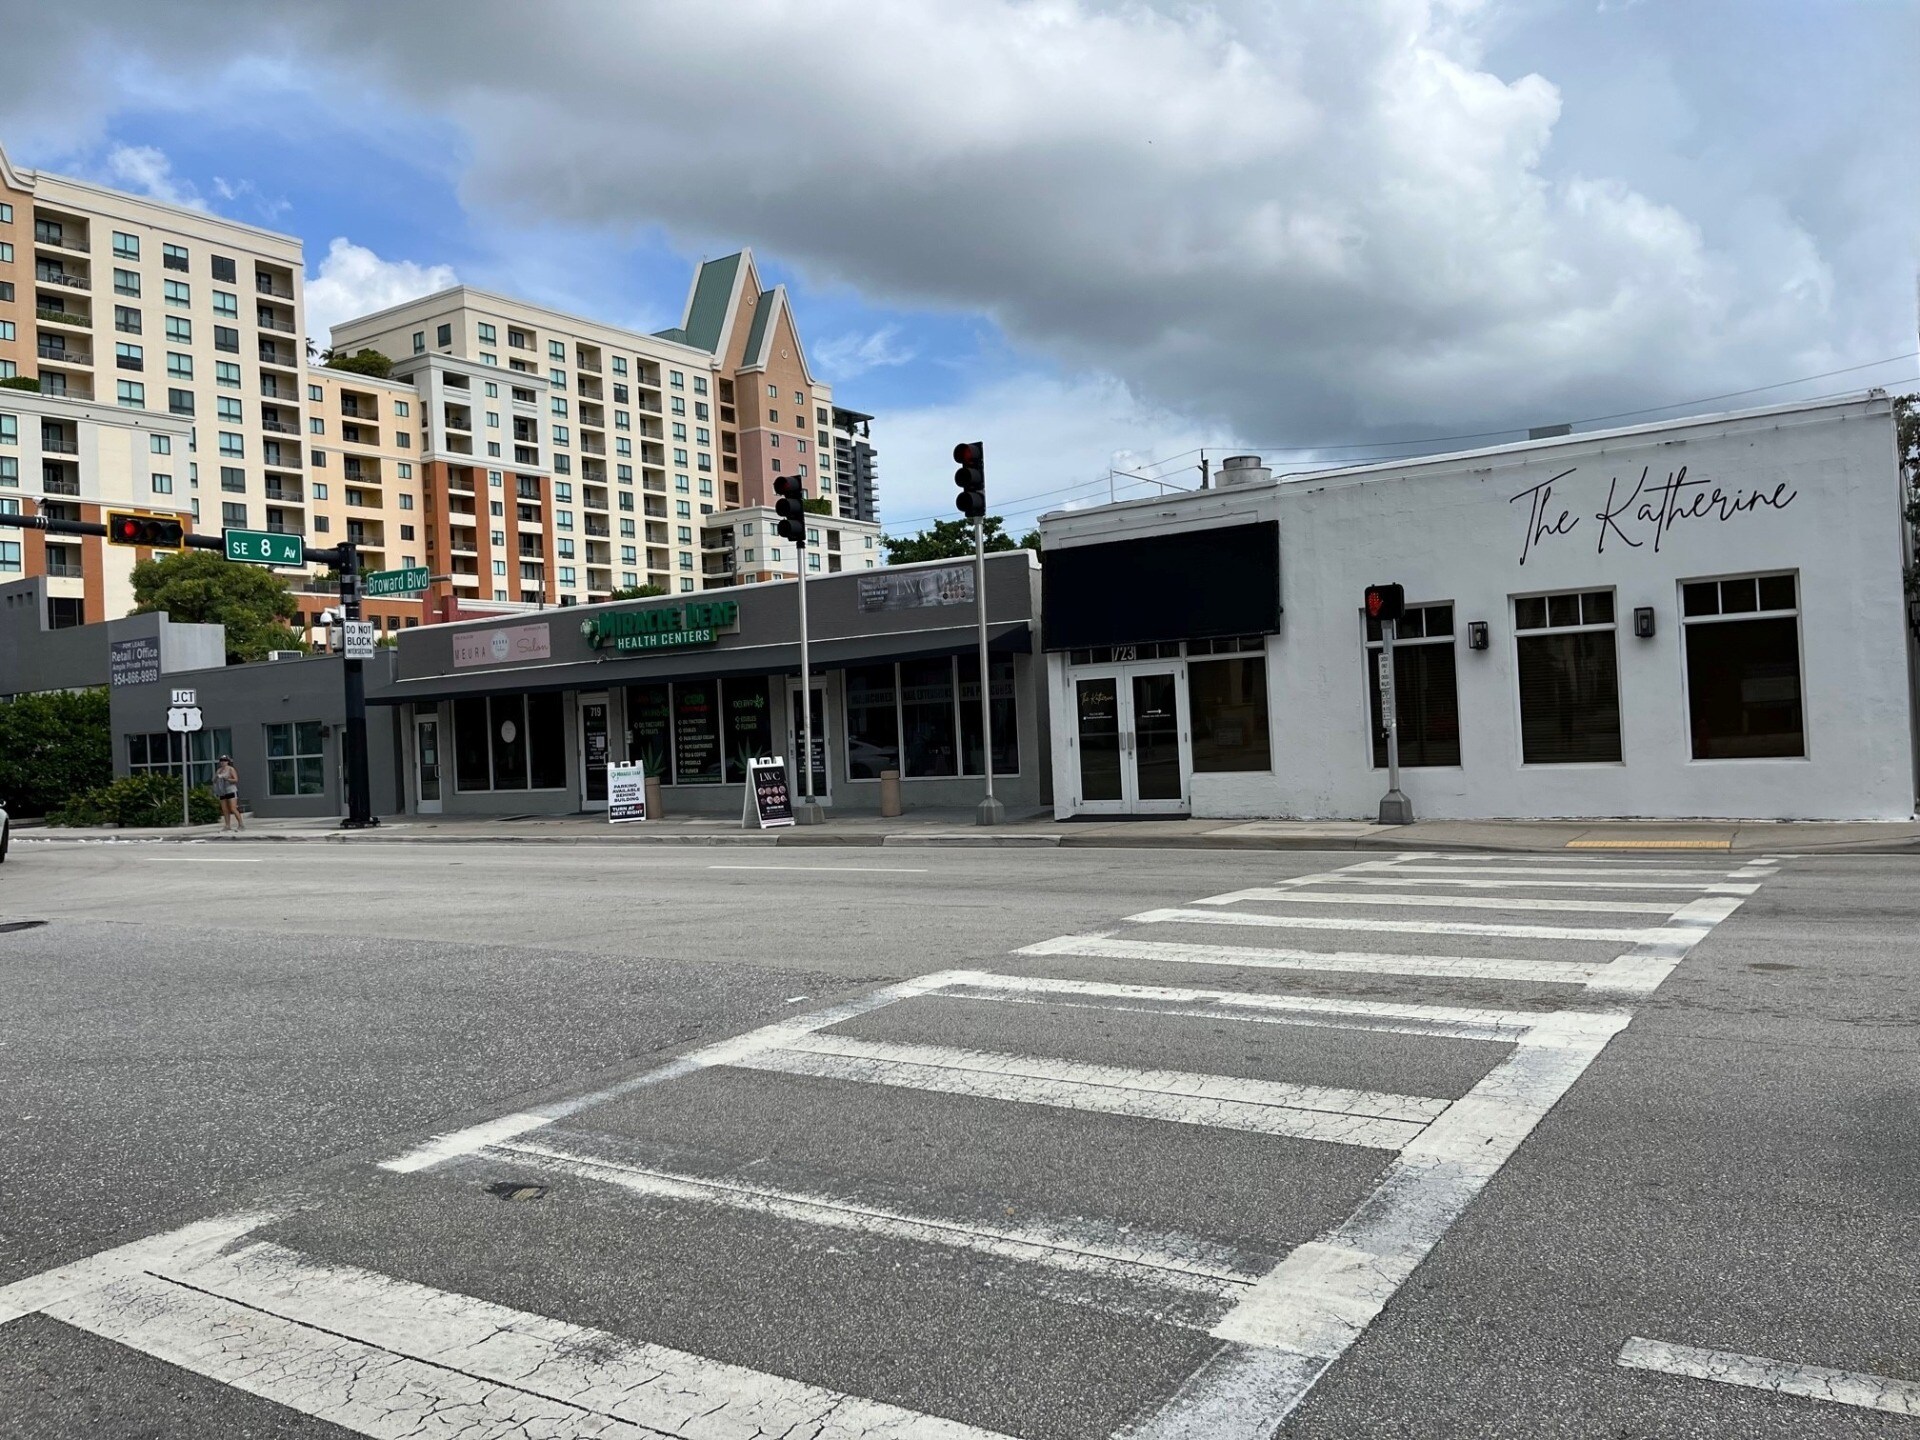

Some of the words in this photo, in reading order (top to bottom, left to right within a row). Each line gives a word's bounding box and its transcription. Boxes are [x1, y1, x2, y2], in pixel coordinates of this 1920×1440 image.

[1509, 467, 1580, 566] The
[1595, 465, 1798, 554] Katherine
[233, 541, 249, 555] SE
[260, 538, 271, 557] 8
[283, 546, 296, 559] Av
[368, 573, 404, 594] Broward
[407, 571, 427, 589] Blvd
[346, 625, 356, 634] DO
[358, 625, 371, 634] NOT
[347, 636, 372, 646] BLOCK
[618, 635, 657, 649] HEALTH
[661, 629, 710, 645] CENTERS
[112, 649, 131, 662] Retail
[137, 647, 158, 659] Office
[173, 691, 194, 703] JCT
[590, 706, 602, 717] 719
[183, 712, 188, 726] 1
[759, 771, 781, 782] LWC
